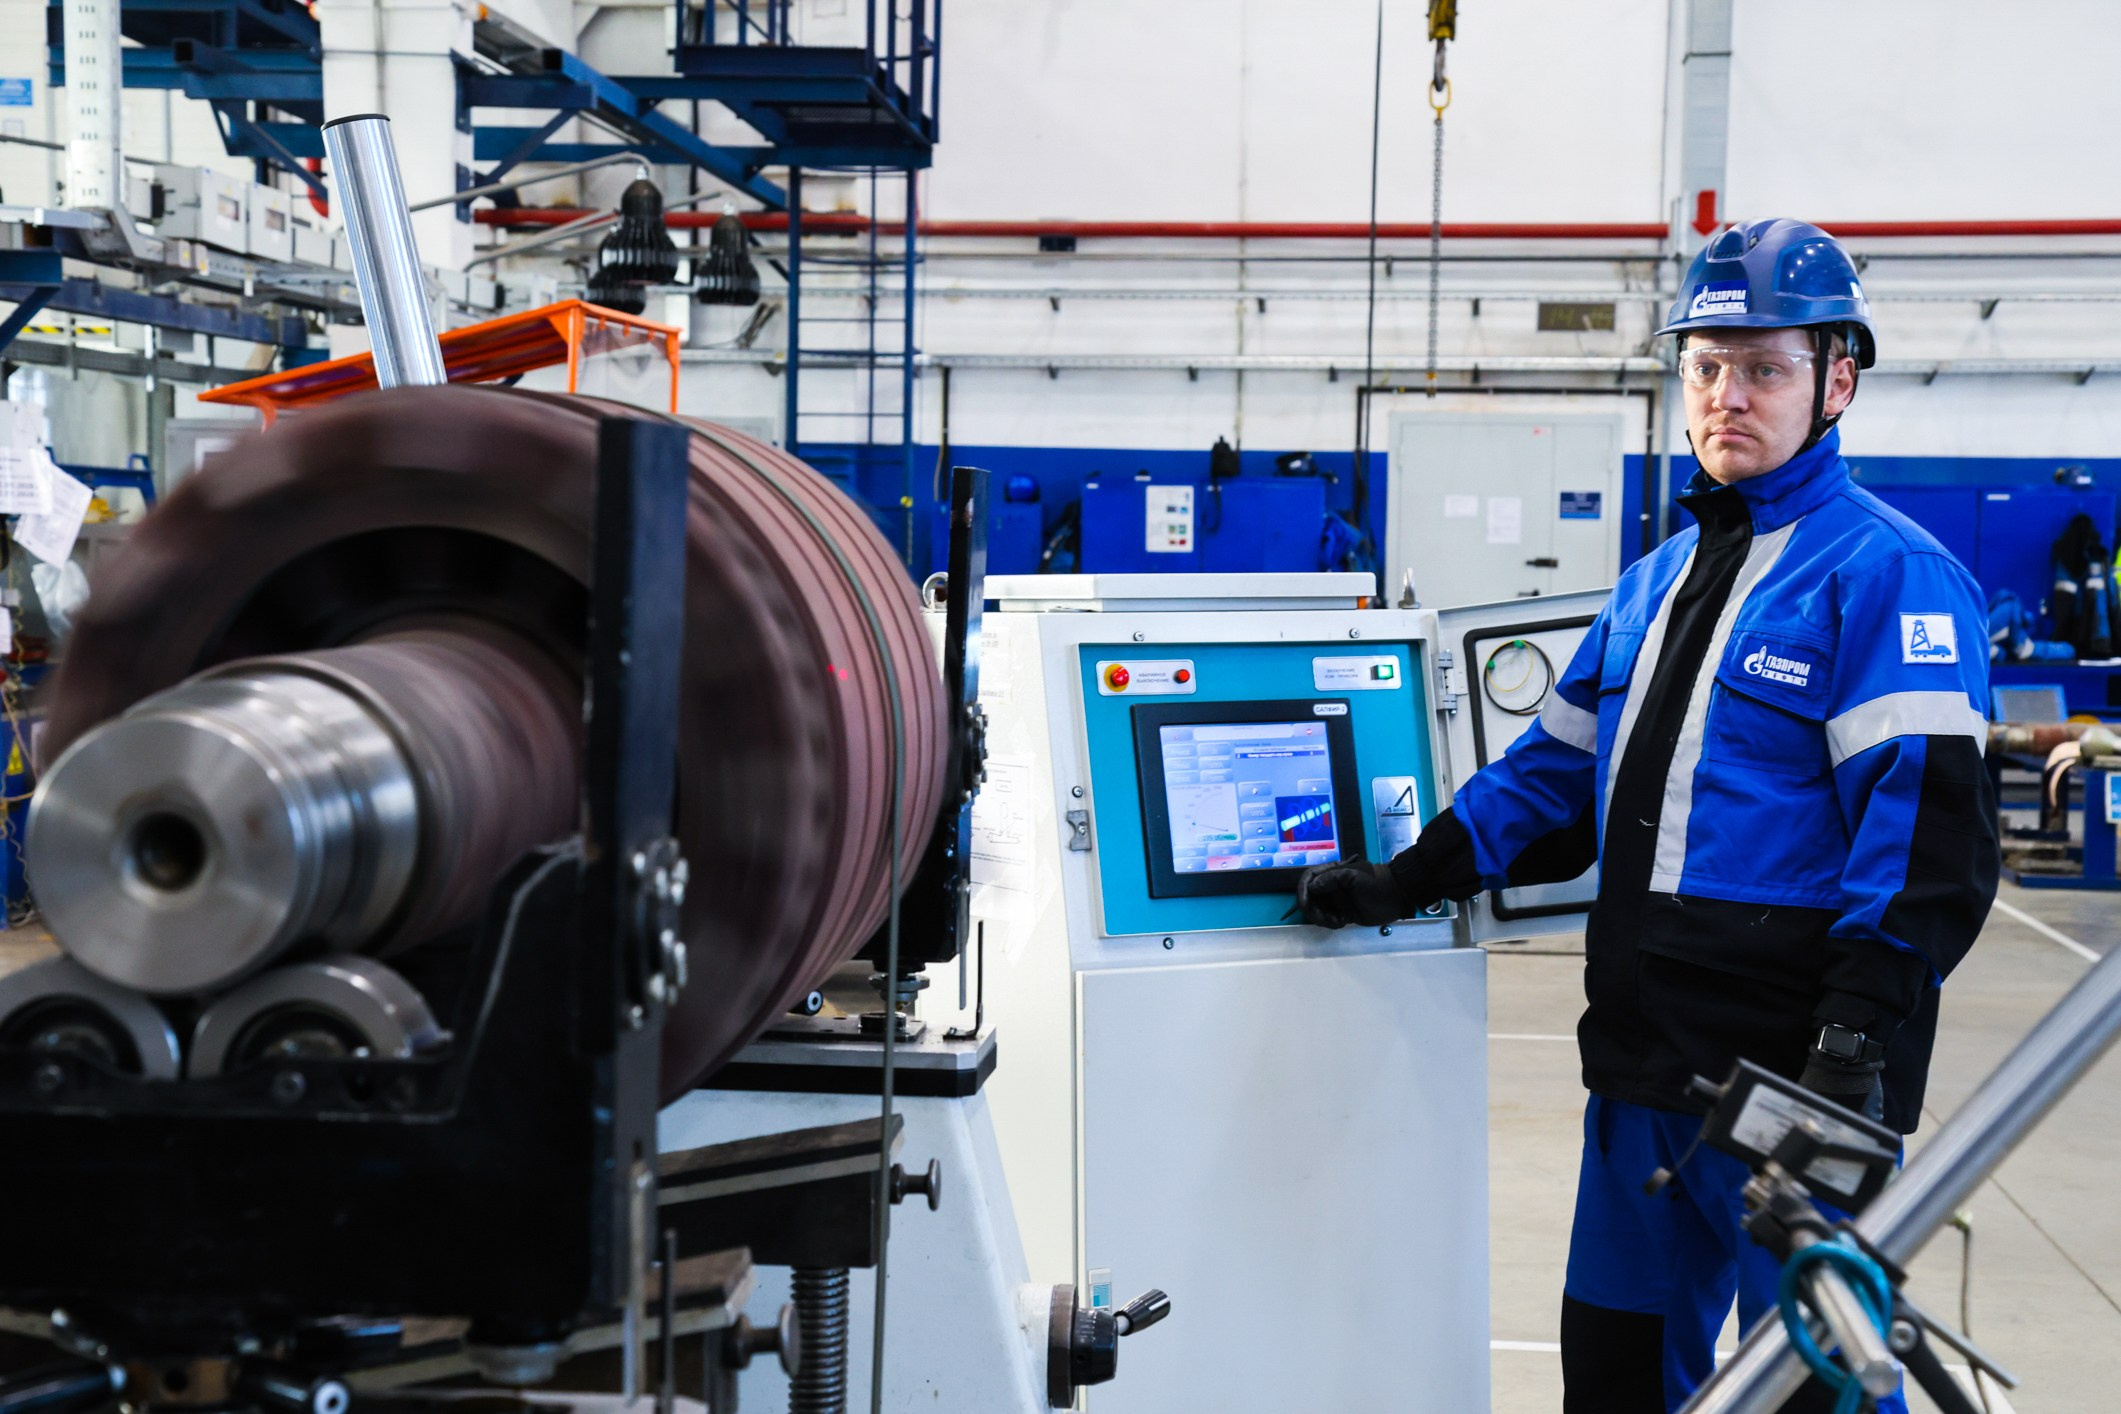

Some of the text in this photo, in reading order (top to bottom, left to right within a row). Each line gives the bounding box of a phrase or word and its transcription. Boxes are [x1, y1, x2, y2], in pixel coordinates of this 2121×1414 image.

[1707, 290, 1746, 302] ГАЗПРОМ
[1765, 655, 1811, 676] ГАЗПРОМ
[1763, 670, 1806, 685] НЕФТЬ
